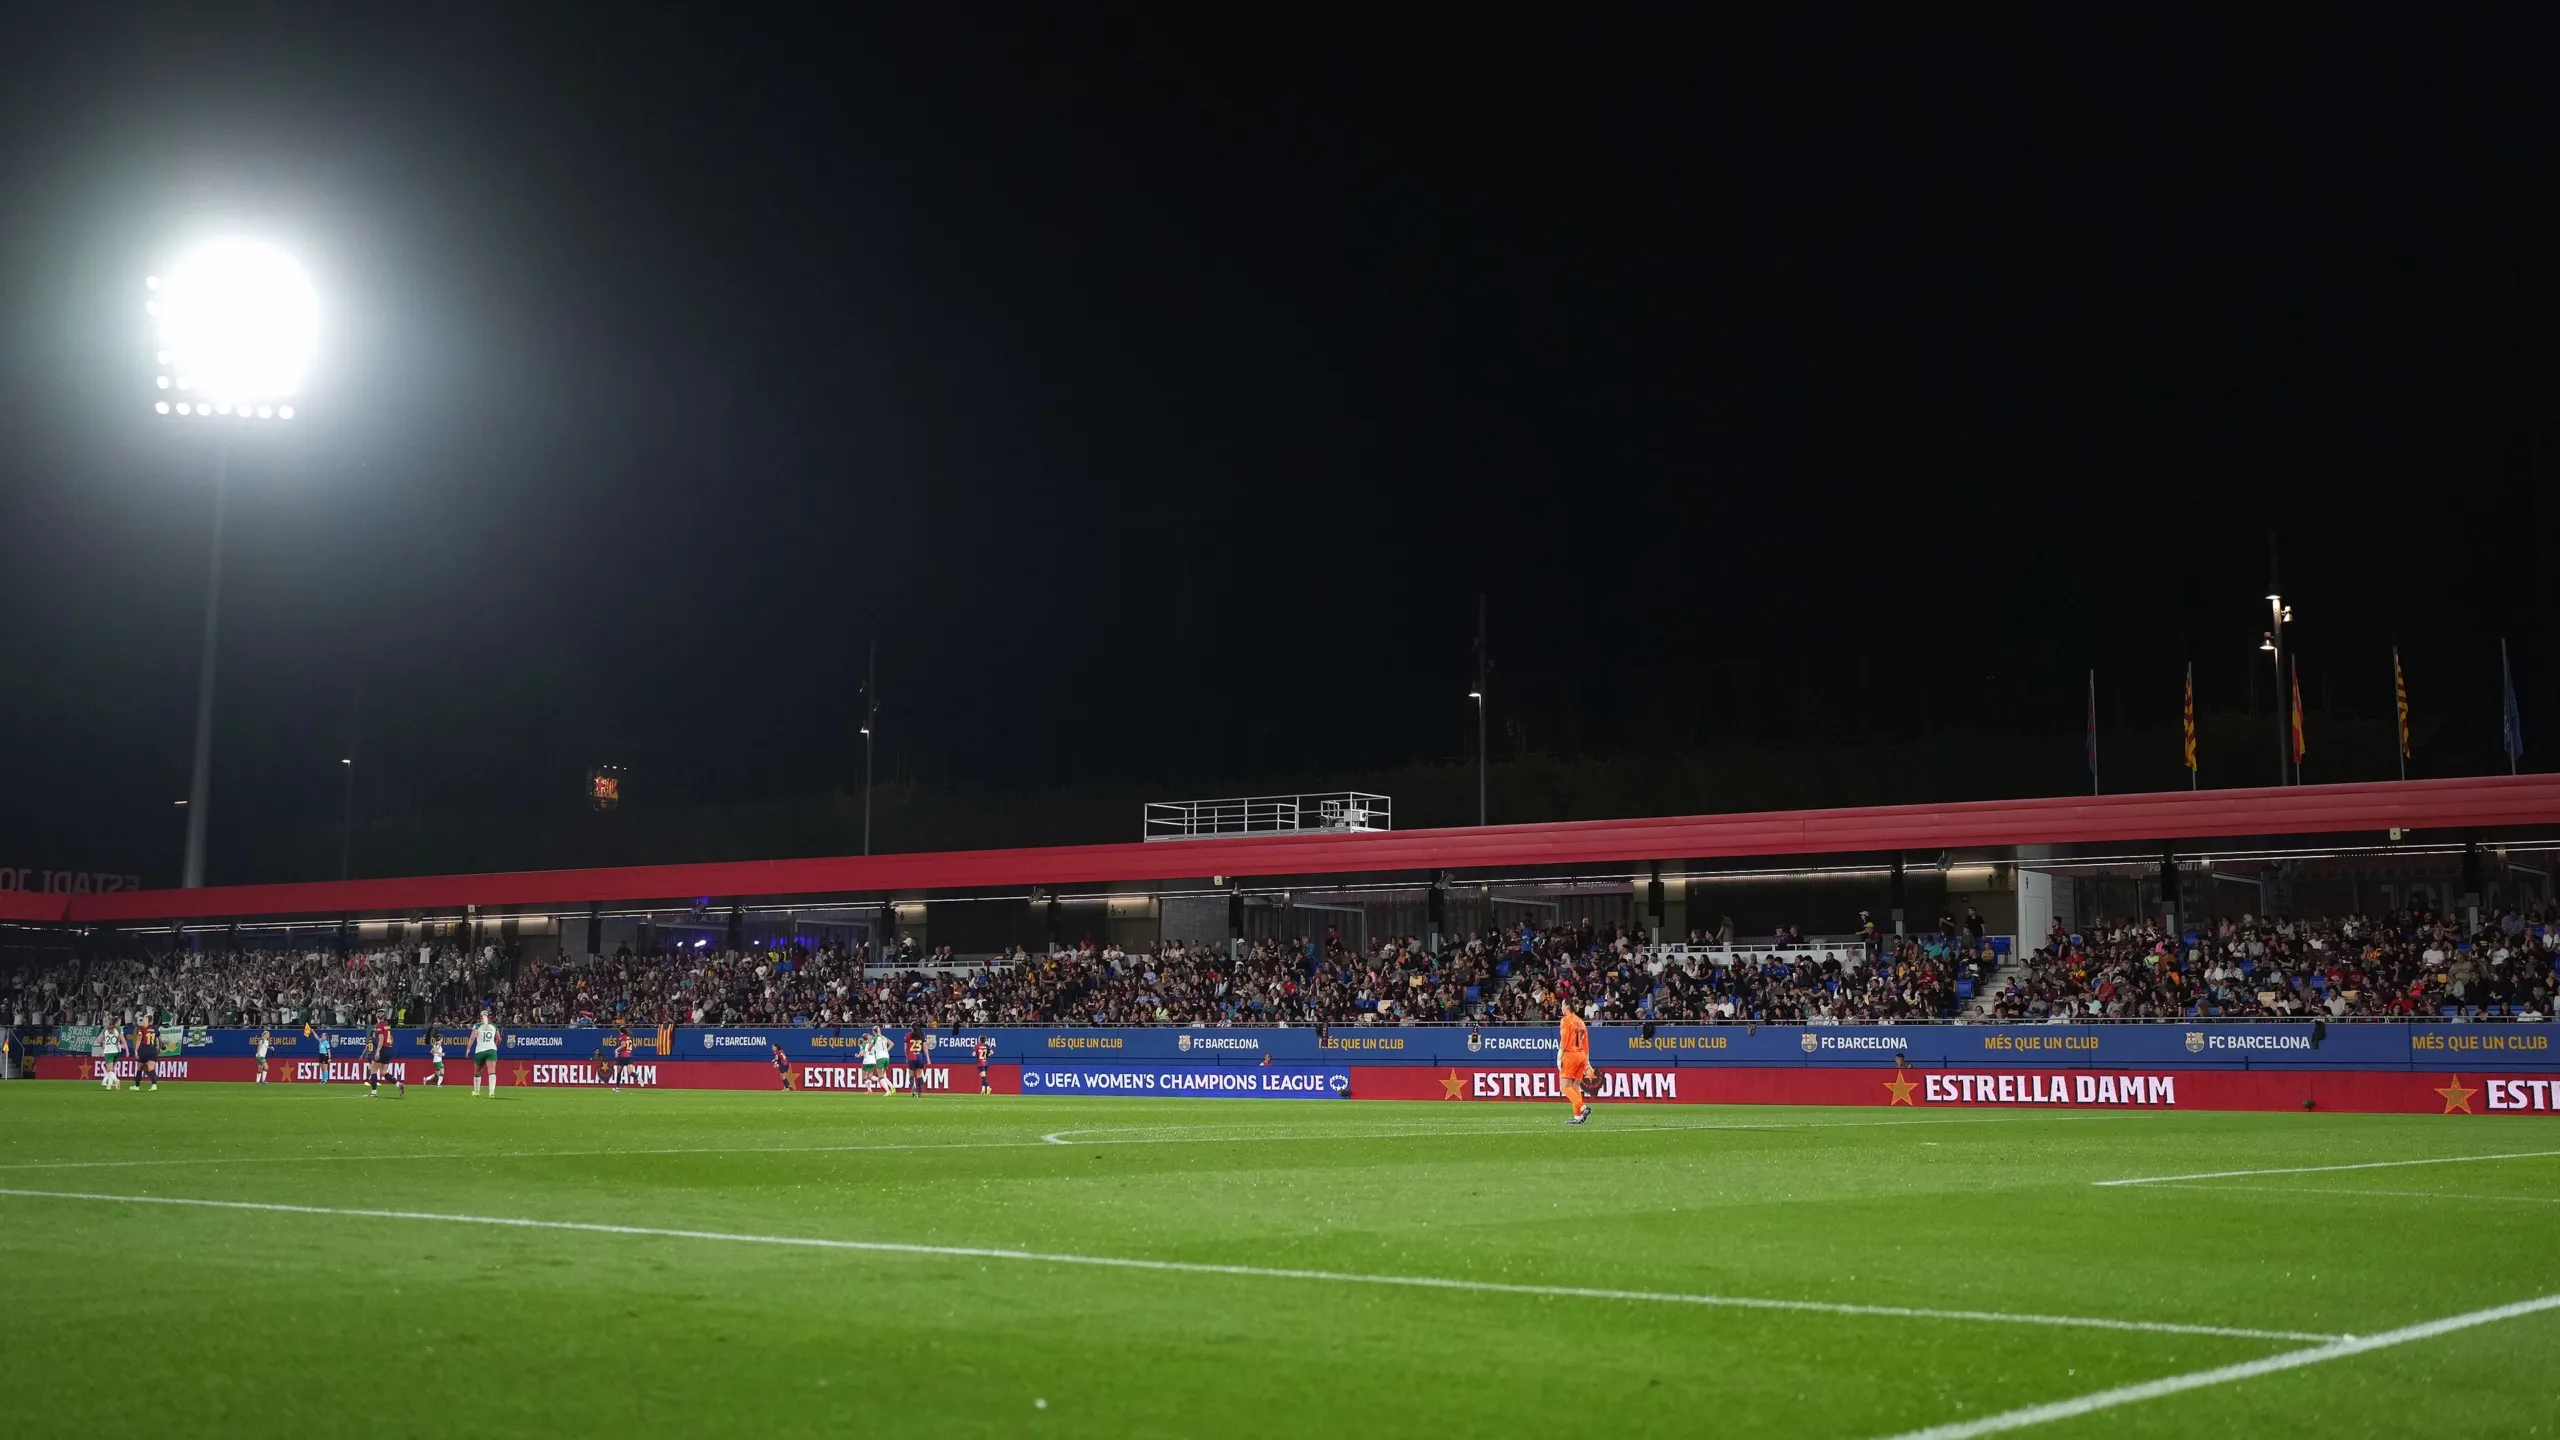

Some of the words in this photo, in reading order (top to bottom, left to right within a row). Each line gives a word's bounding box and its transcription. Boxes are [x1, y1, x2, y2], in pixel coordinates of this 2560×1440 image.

[106, 1035, 119, 1046] 20
[146, 1032, 156, 1045] 11
[282, 1037, 297, 1045] CLUB
[340, 1037, 350, 1046] FC
[351, 1037, 366, 1046] BARCE
[453, 1037, 470, 1046] CLUB
[482, 1031, 493, 1043] 19
[517, 1037, 525, 1046] FC
[526, 1037, 563, 1046] BARCELONA
[603, 1035, 617, 1046] MÉS
[644, 1037, 657, 1047] CLU
[715, 1036, 724, 1046] FC
[725, 1036, 767, 1046] BARCELONA
[811, 1035, 827, 1047] MÉS
[828, 1037, 843, 1048] QUE
[844, 1038, 857, 1047] UN
[938, 1037, 948, 1047] FC
[1048, 1035, 1066, 1048] MÉS
[1067, 1038, 1085, 1050] QUE
[1087, 1038, 1099, 1048] UN
[1100, 1038, 1123, 1048] CLUB
[1193, 1038, 1204, 1049] FC
[1205, 1038, 1259, 1049] BARCELONA
[1319, 1036, 1338, 1049] ÉS
[1341, 1038, 1360, 1050] QUE
[1363, 1038, 1377, 1049] UN
[1379, 1038, 1404, 1049] CLUB
[1484, 1037, 1496, 1049] FC
[1498, 1037, 1559, 1049] BARCELONA
[1628, 1034, 1652, 1049] MÉS
[1654, 1037, 1678, 1050] QUE
[1680, 1037, 1696, 1049] UN
[1698, 1037, 1727, 1049] CLUB
[1821, 1036, 1835, 1049] FC
[1837, 1036, 1908, 1049] BARCELONA
[1984, 1033, 2012, 1050] MÉS
[2014, 1037, 2040, 1051] QUE
[2043, 1037, 2062, 1049] UN
[2065, 1036, 2099, 1049] CLUB
[2209, 1036, 2225, 1049] FC
[2227, 1036, 2311, 1050] BARCELONA
[2412, 1032, 2444, 1050] MÉS
[2447, 1036, 2479, 1051] QUE
[2484, 1036, 2505, 1049] UN
[2507, 1036, 2549, 1050] CLUB
[909, 1039, 922, 1052] 23
[297, 1062, 360, 1080] ESTELLA
[804, 1067, 882, 1089] ESTREL
[1045, 1072, 1080, 1088] UEFA
[1084, 1073, 1155, 1089] WOMEN'S
[1160, 1073, 1257, 1090] CHAMPIONS
[1262, 1074, 1324, 1091] LEAGUE
[1473, 1072, 1591, 1098] ESTREL
[1925, 1074, 2070, 1103] ESTRELLA
[2075, 1075, 2176, 1104] DAMM
